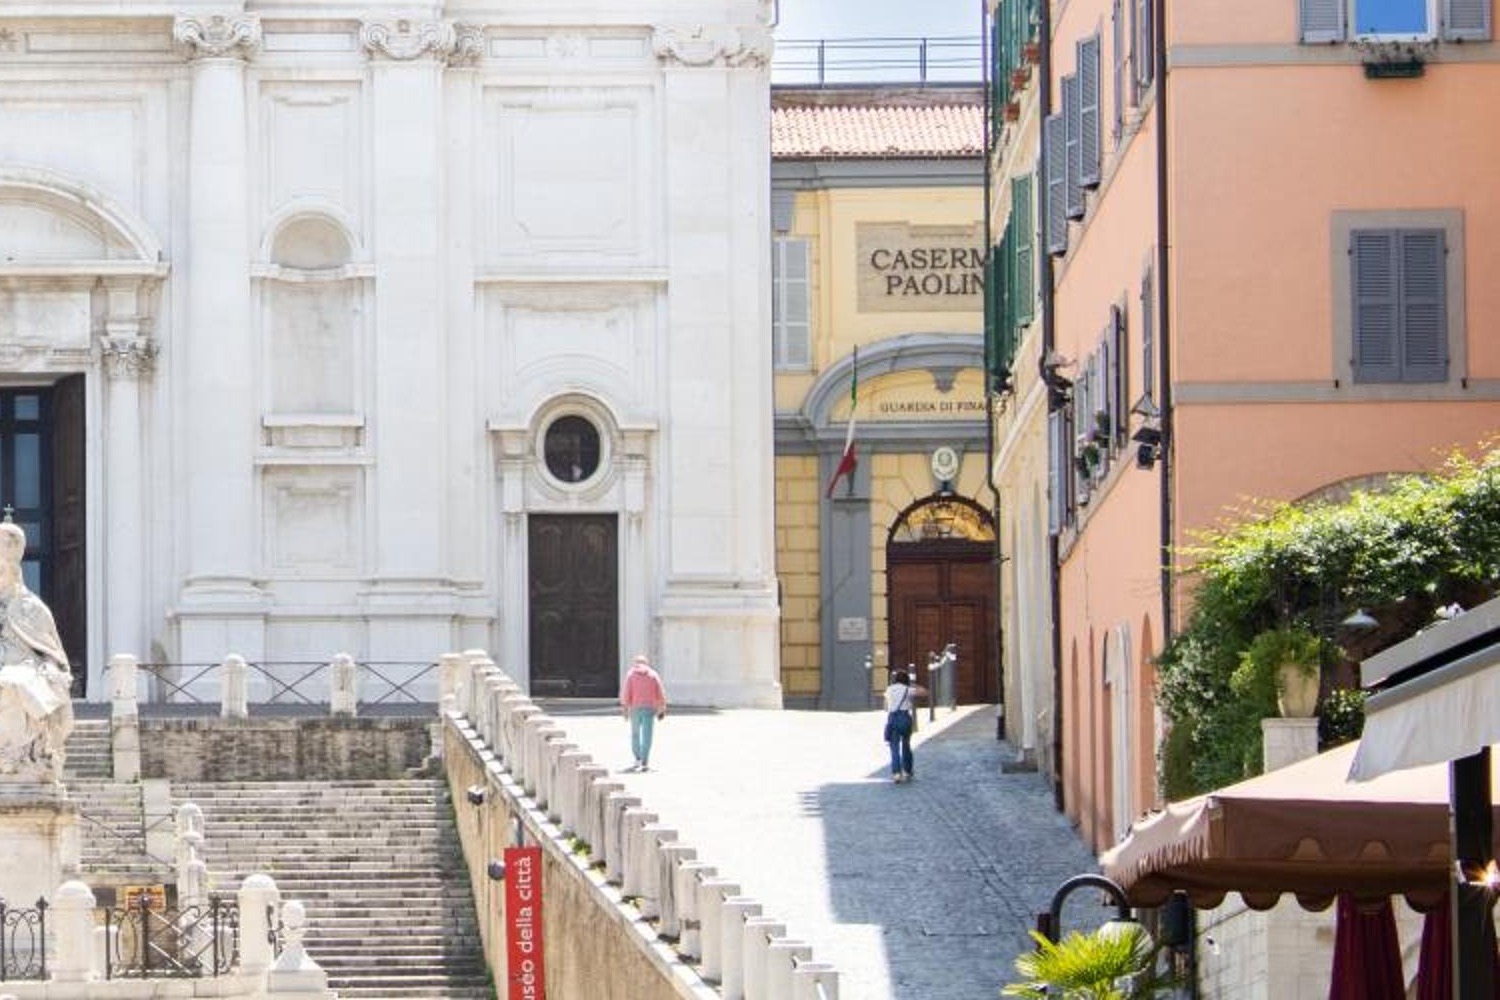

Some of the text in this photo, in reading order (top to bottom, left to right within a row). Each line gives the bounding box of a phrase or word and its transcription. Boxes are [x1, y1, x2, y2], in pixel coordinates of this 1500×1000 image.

[940, 401, 953, 413] DI
[514, 856, 532, 901] città
[516, 907, 533, 953] della
